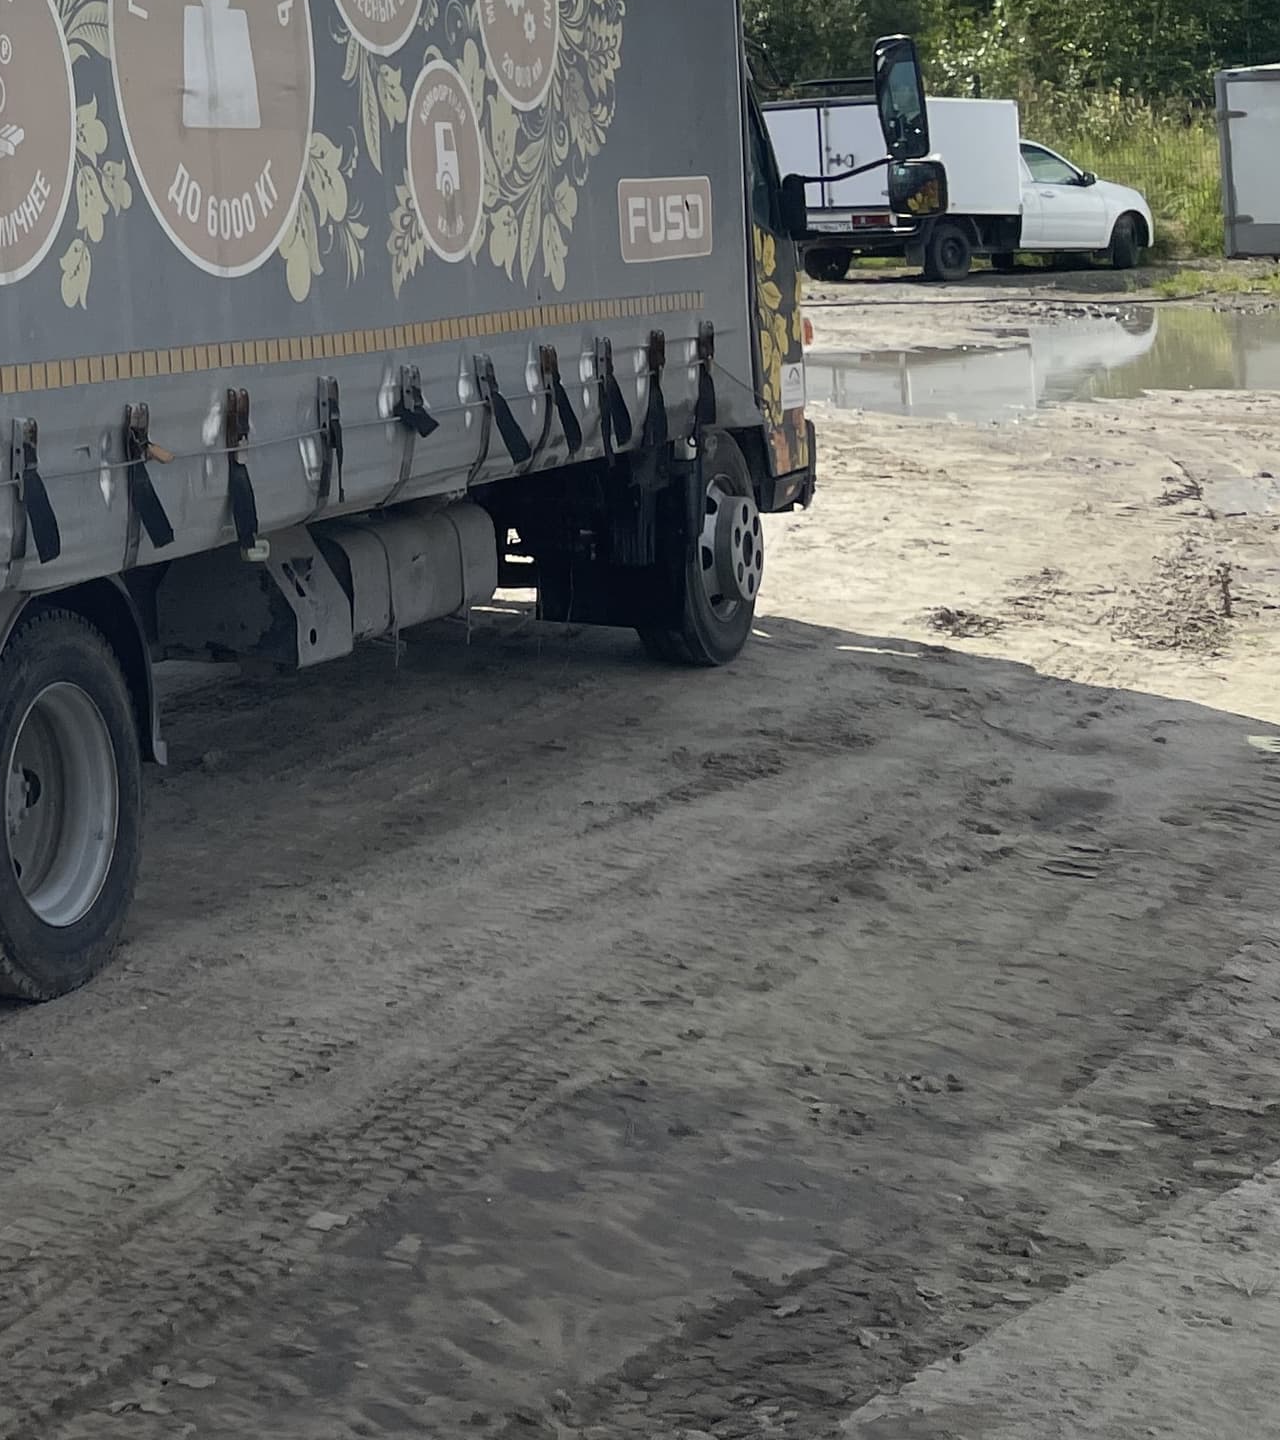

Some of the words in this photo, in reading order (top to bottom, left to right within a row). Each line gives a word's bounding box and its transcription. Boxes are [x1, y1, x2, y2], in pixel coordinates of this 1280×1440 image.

[167, 162, 202, 224] ДО
[207, 192, 256, 241] 6000
[255, 159, 280, 219] КГ
[627, 193, 704, 244] FUSO
